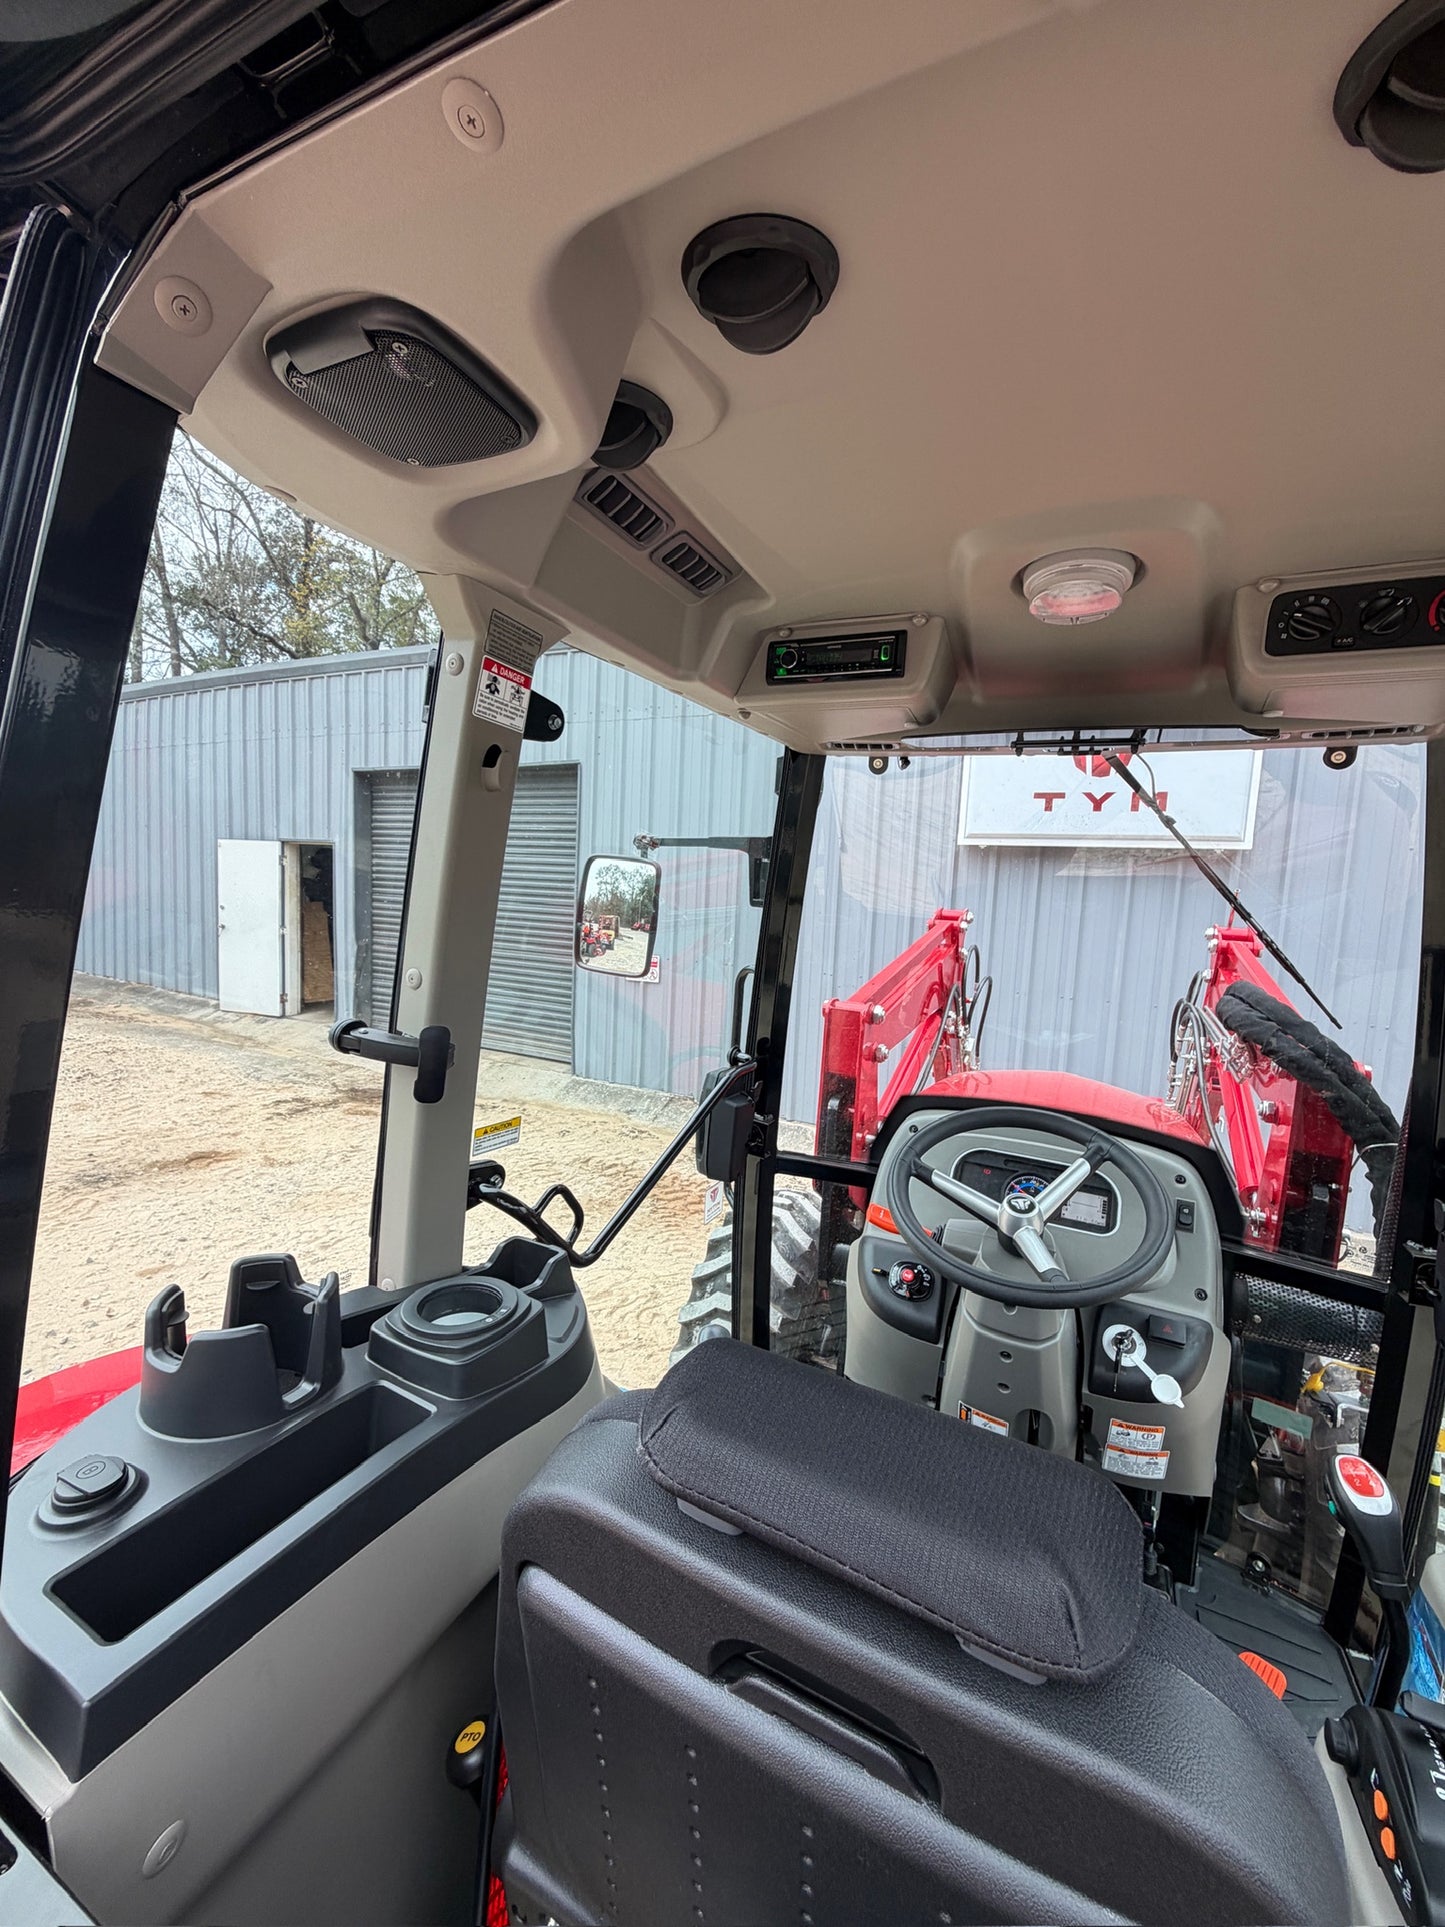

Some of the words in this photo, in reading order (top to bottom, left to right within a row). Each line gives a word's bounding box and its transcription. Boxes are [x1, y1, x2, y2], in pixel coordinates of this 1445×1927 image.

[500, 667, 525, 685] DANGER
[1033, 791, 1169, 812] TYM
[489, 1121, 513, 1133] CAUTION
[1125, 1423, 1160, 1433] WARNING
[460, 1732, 481, 1741] PTO
